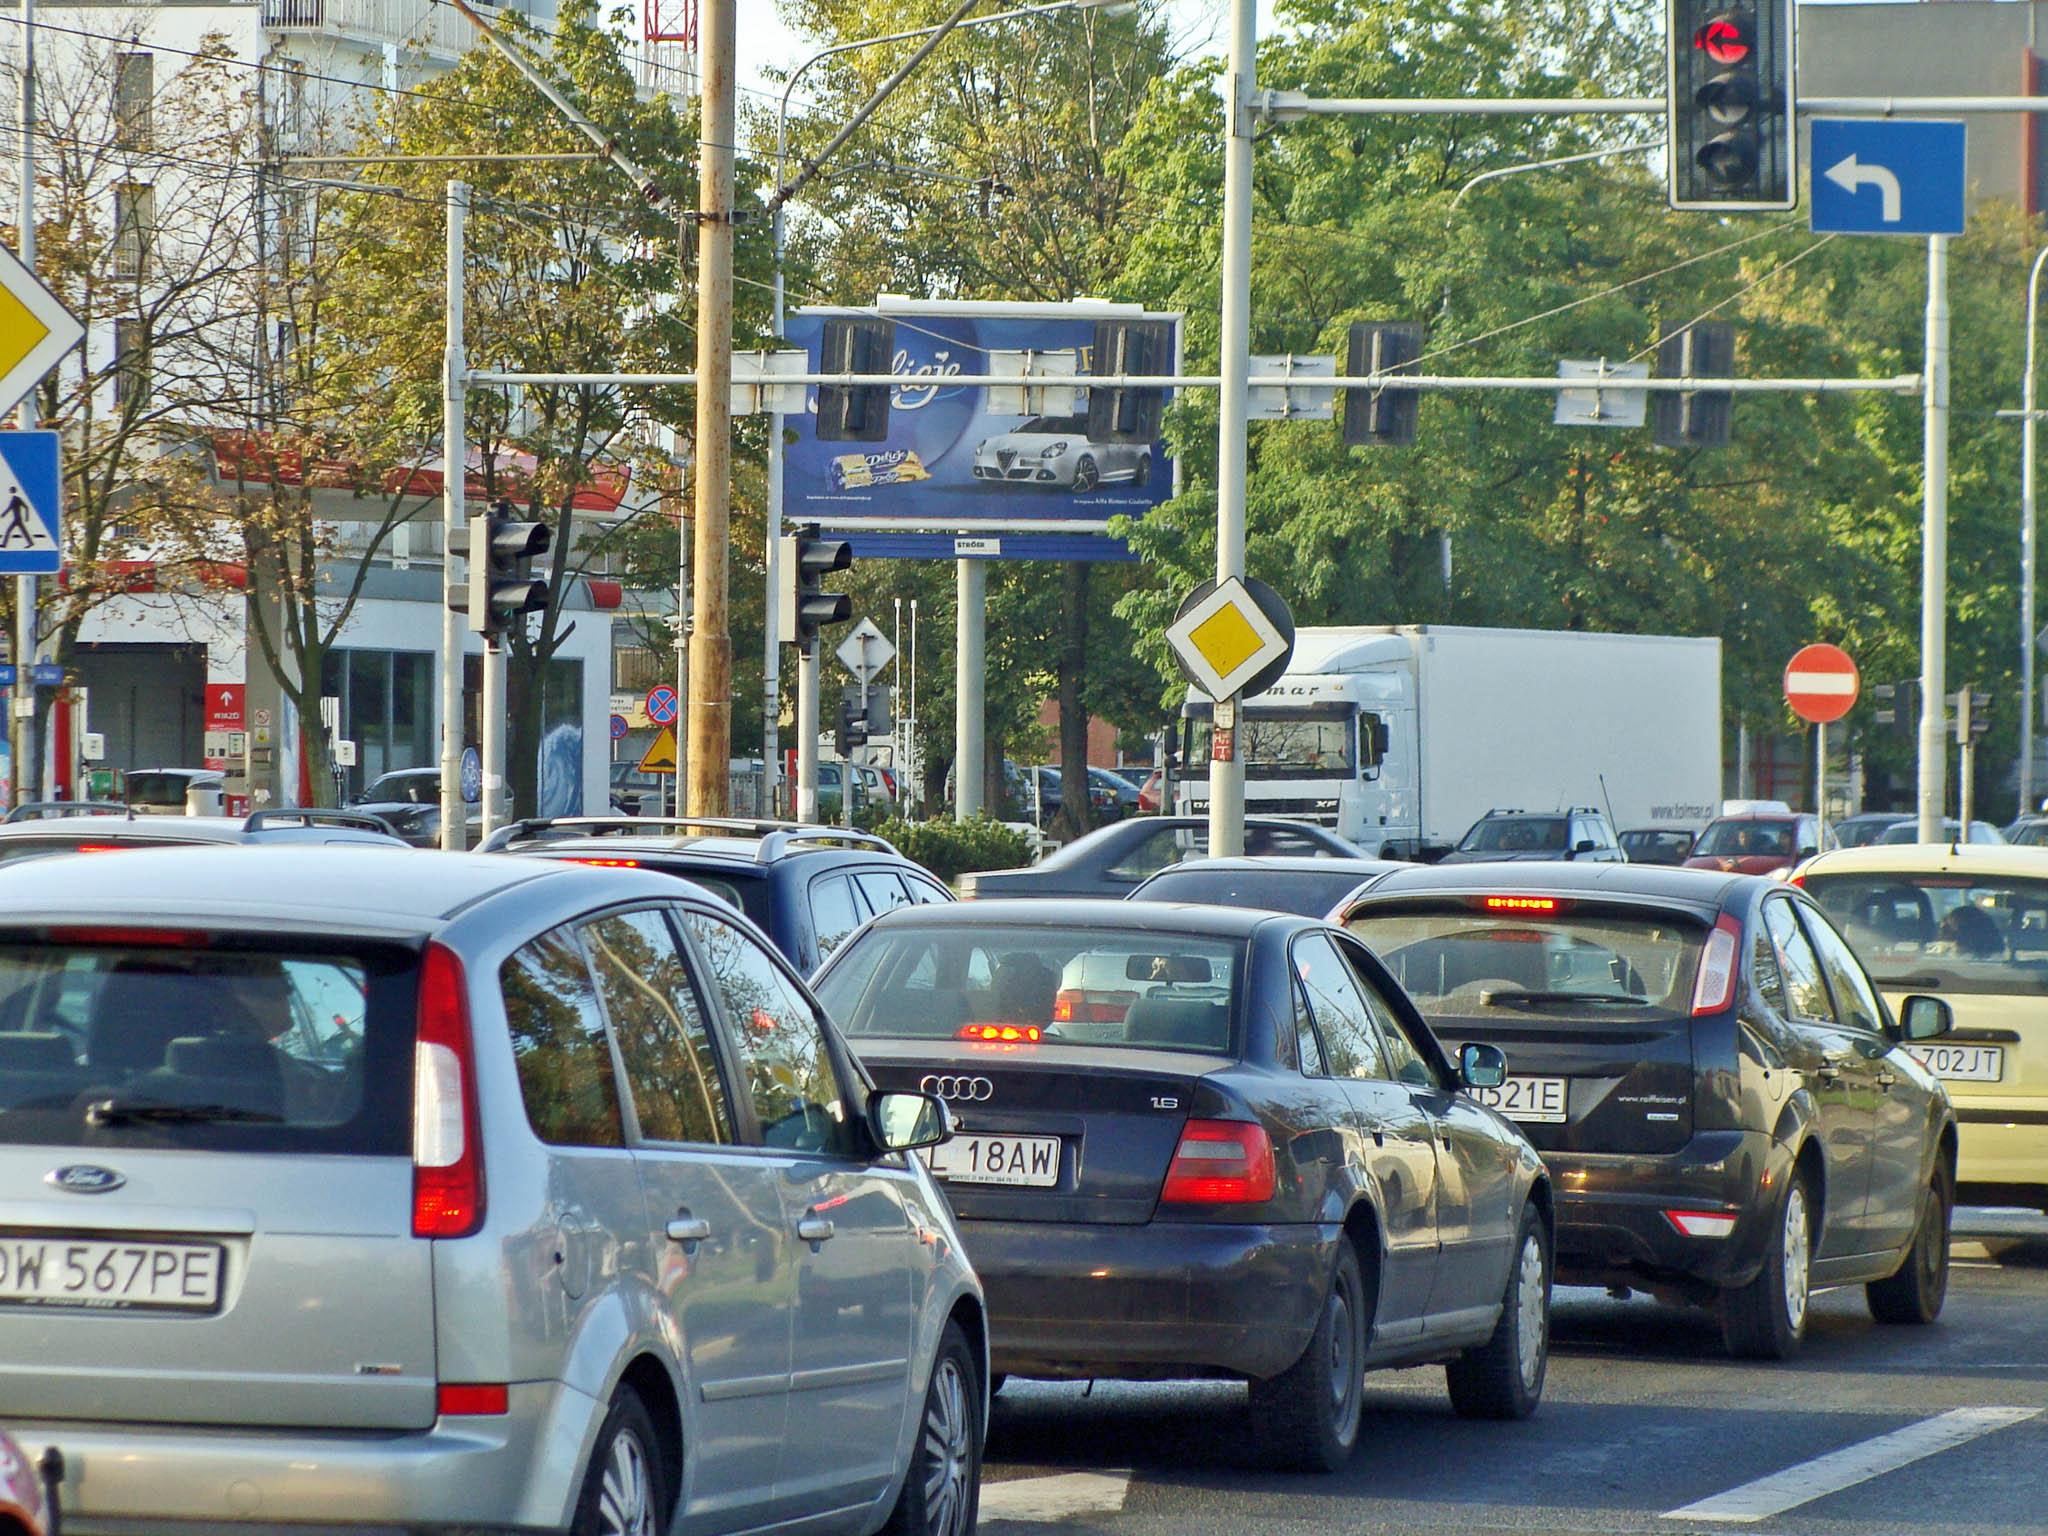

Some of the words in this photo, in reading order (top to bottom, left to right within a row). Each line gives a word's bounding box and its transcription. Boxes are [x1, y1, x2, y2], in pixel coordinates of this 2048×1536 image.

[1315, 800, 1338, 808] XF
[968, 1140, 1052, 1175] 18AW
[64, 1247, 211, 1297] 567PE
